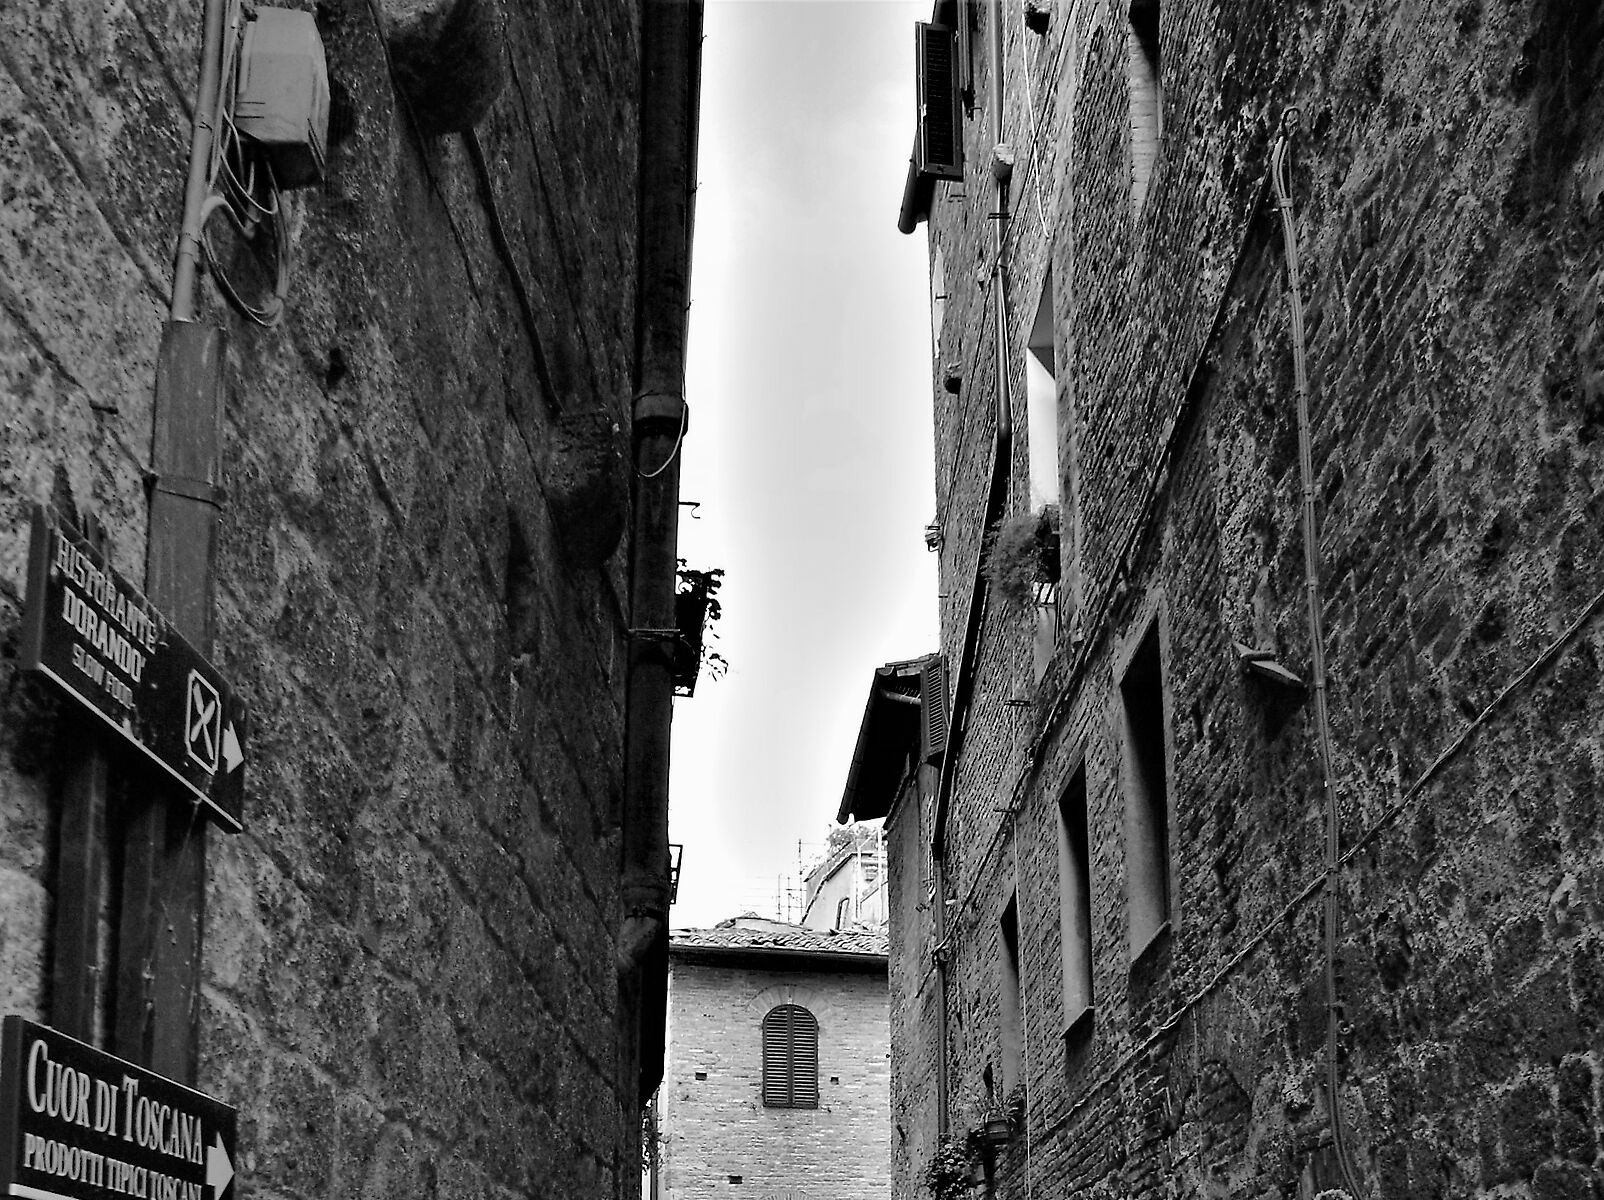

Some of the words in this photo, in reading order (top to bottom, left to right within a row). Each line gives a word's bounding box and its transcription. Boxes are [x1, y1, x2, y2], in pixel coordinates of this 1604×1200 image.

[57, 534, 156, 655] RISTORANTE
[27, 1039, 91, 1128] CUOR
[94, 1079, 119, 1136] DI
[122, 1073, 204, 1165] TOSCANA
[24, 1132, 104, 1187] PRODOTTI
[106, 1157, 148, 1199] TIPICI
